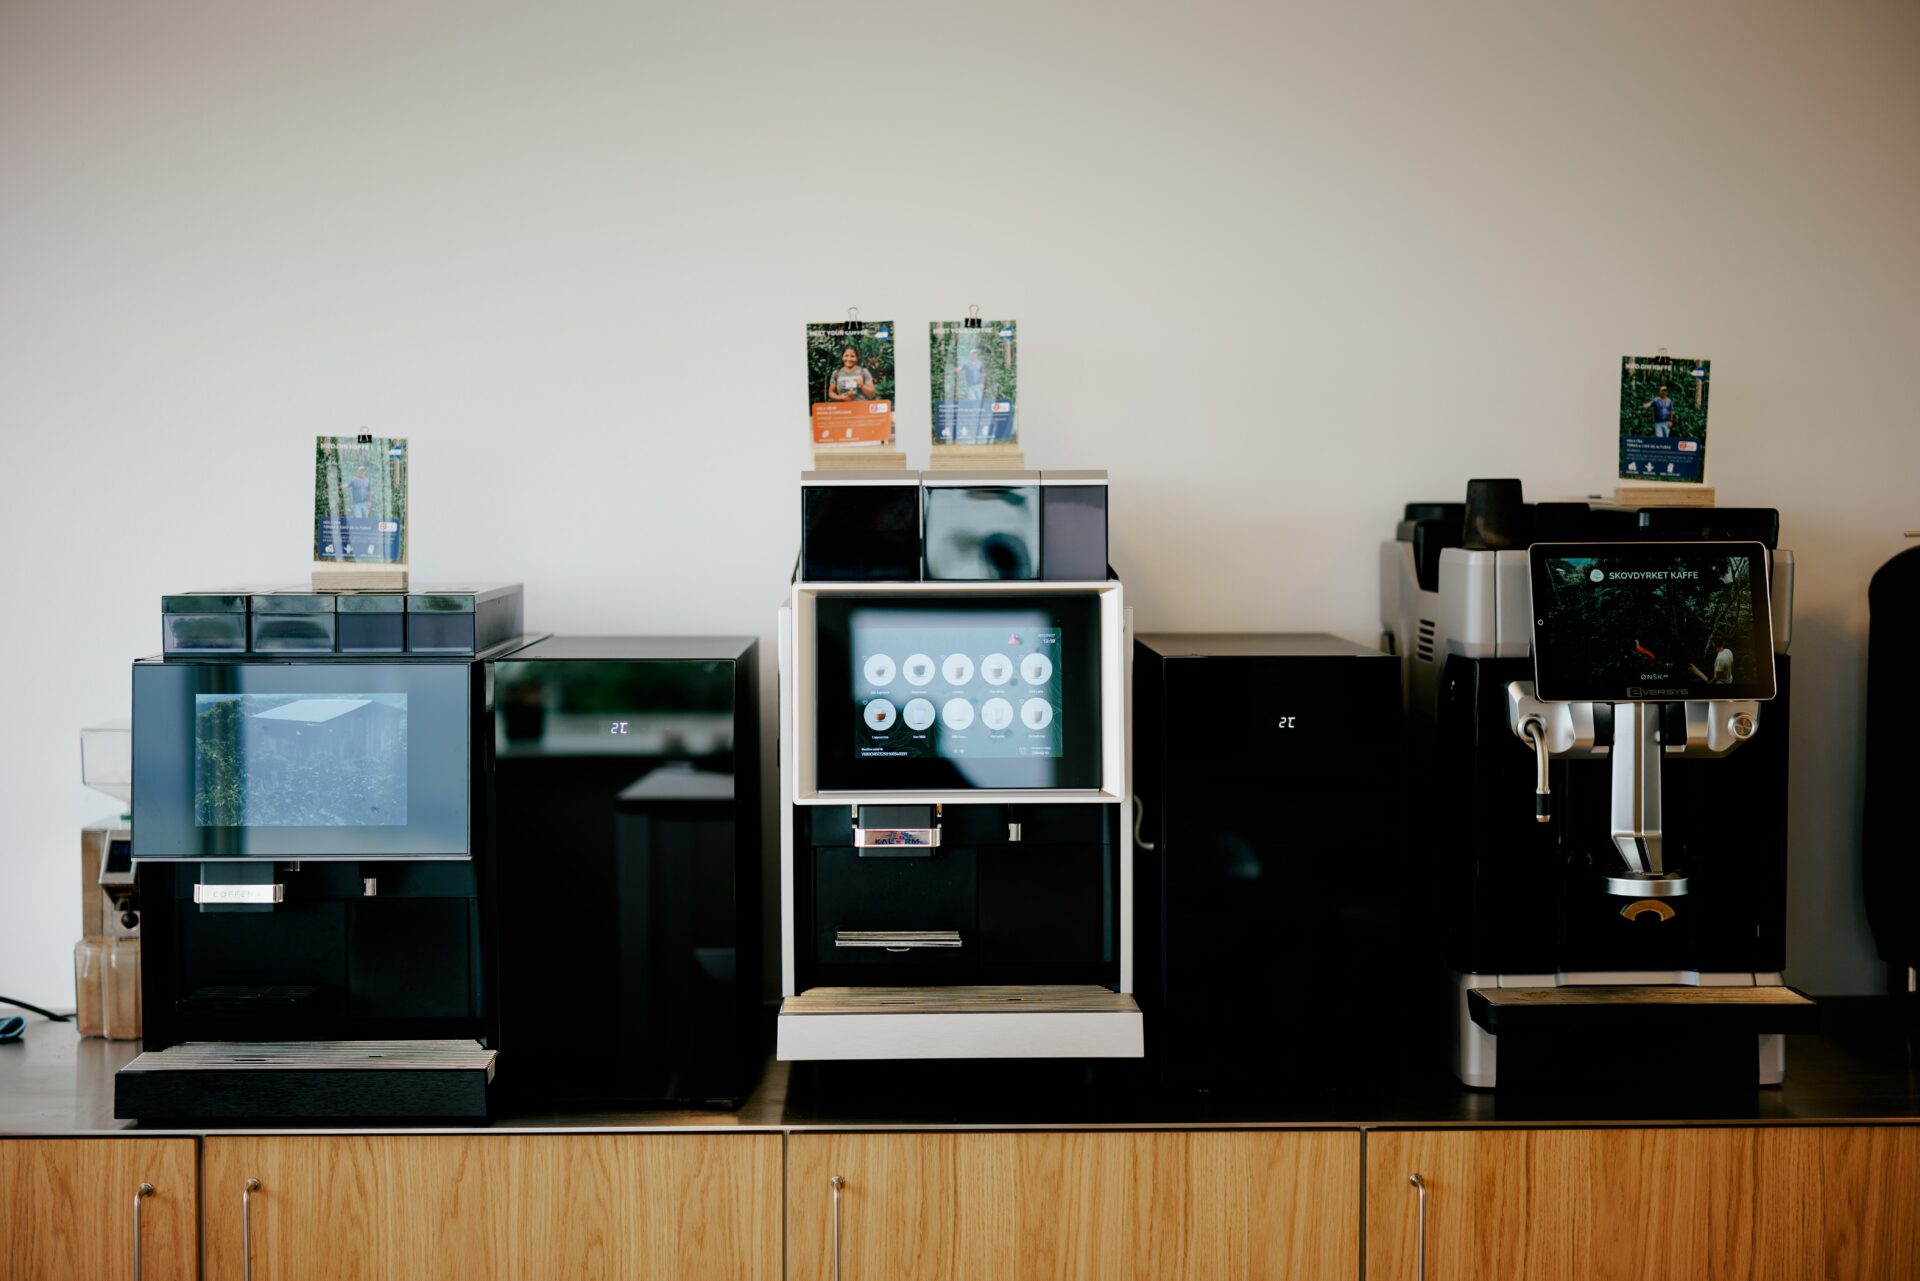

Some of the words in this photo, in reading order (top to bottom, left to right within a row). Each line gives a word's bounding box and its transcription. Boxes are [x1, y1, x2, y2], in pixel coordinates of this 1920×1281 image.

[1609, 571, 1668, 580] SKOVDYRKET
[1670, 571, 1699, 579] KAFFE
[212, 889, 263, 898] COFFEM
